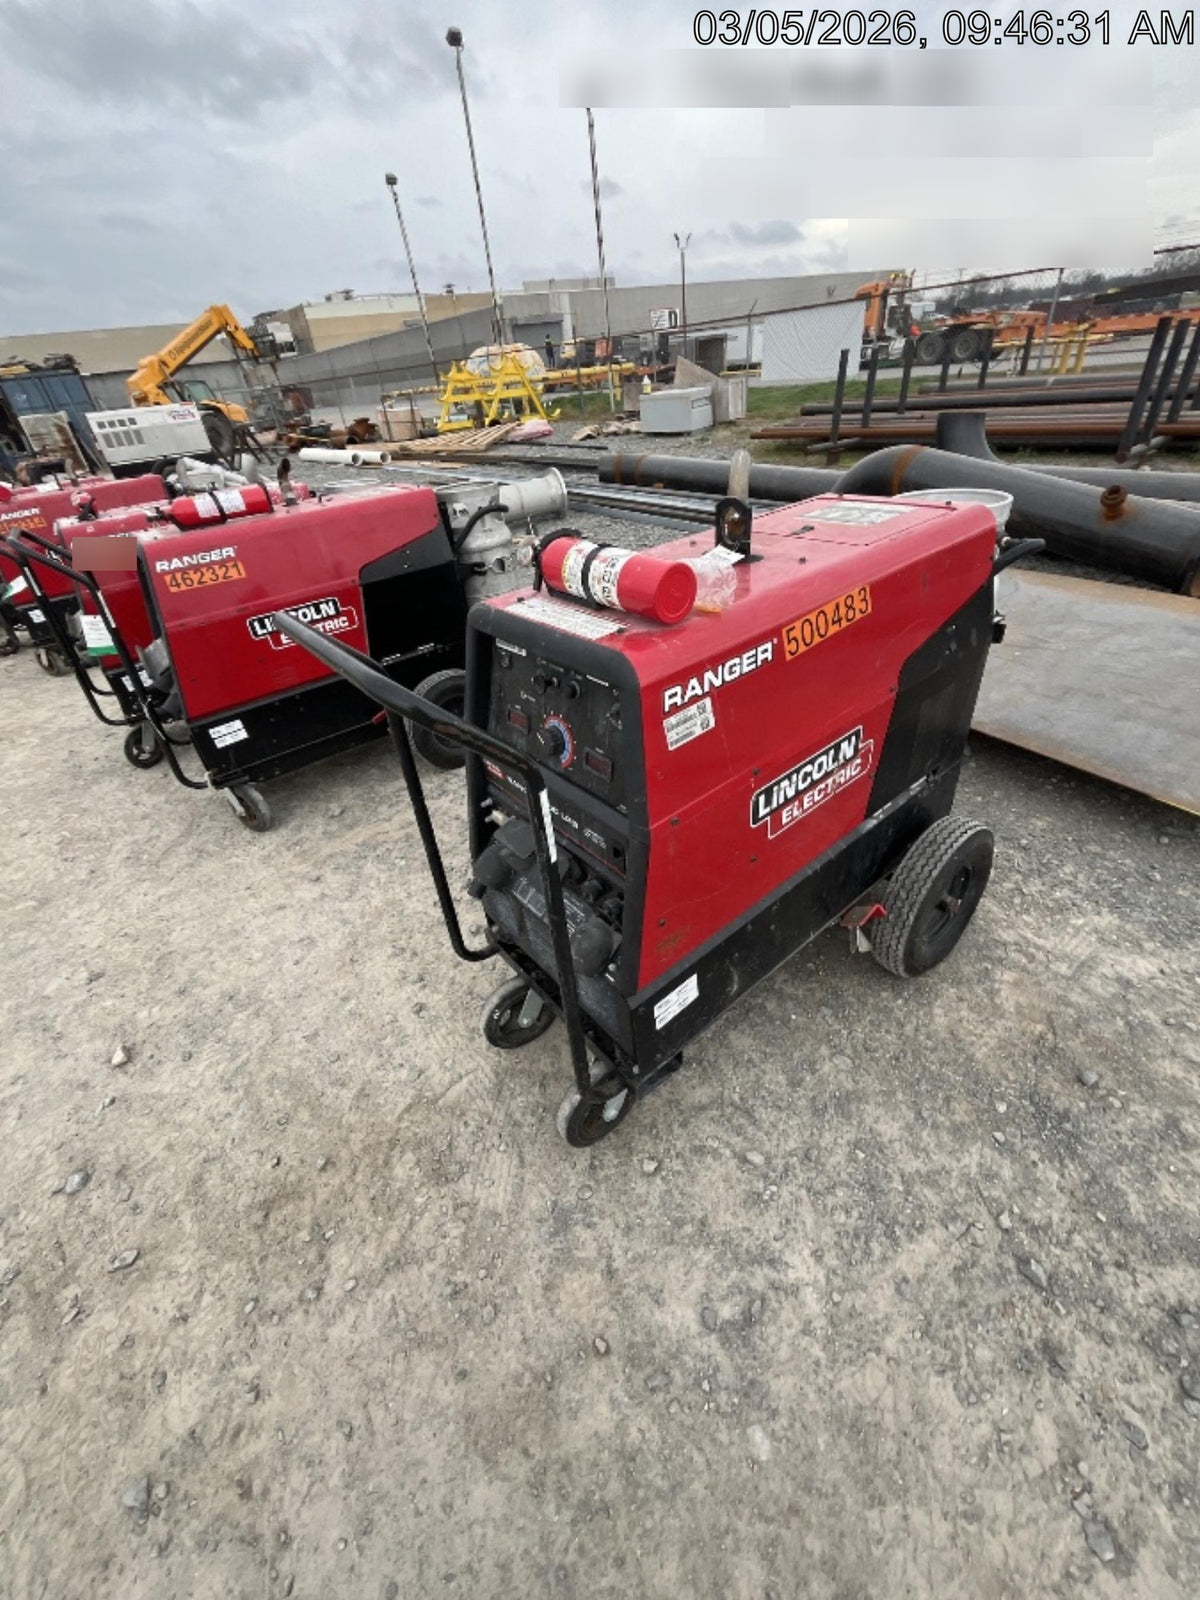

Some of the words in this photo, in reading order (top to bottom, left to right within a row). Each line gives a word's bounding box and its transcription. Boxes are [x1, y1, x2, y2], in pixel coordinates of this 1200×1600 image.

[155, 546, 236, 573] RANGER
[169, 562, 243, 589] 462321
[253, 600, 337, 635] LIOLN
[280, 616, 350, 645] ETRIC
[785, 586, 870, 656] 500483
[663, 640, 775, 713] RANGER
[758, 735, 856, 818] LINCOLN
[781, 758, 862, 826] ELECTRIC
